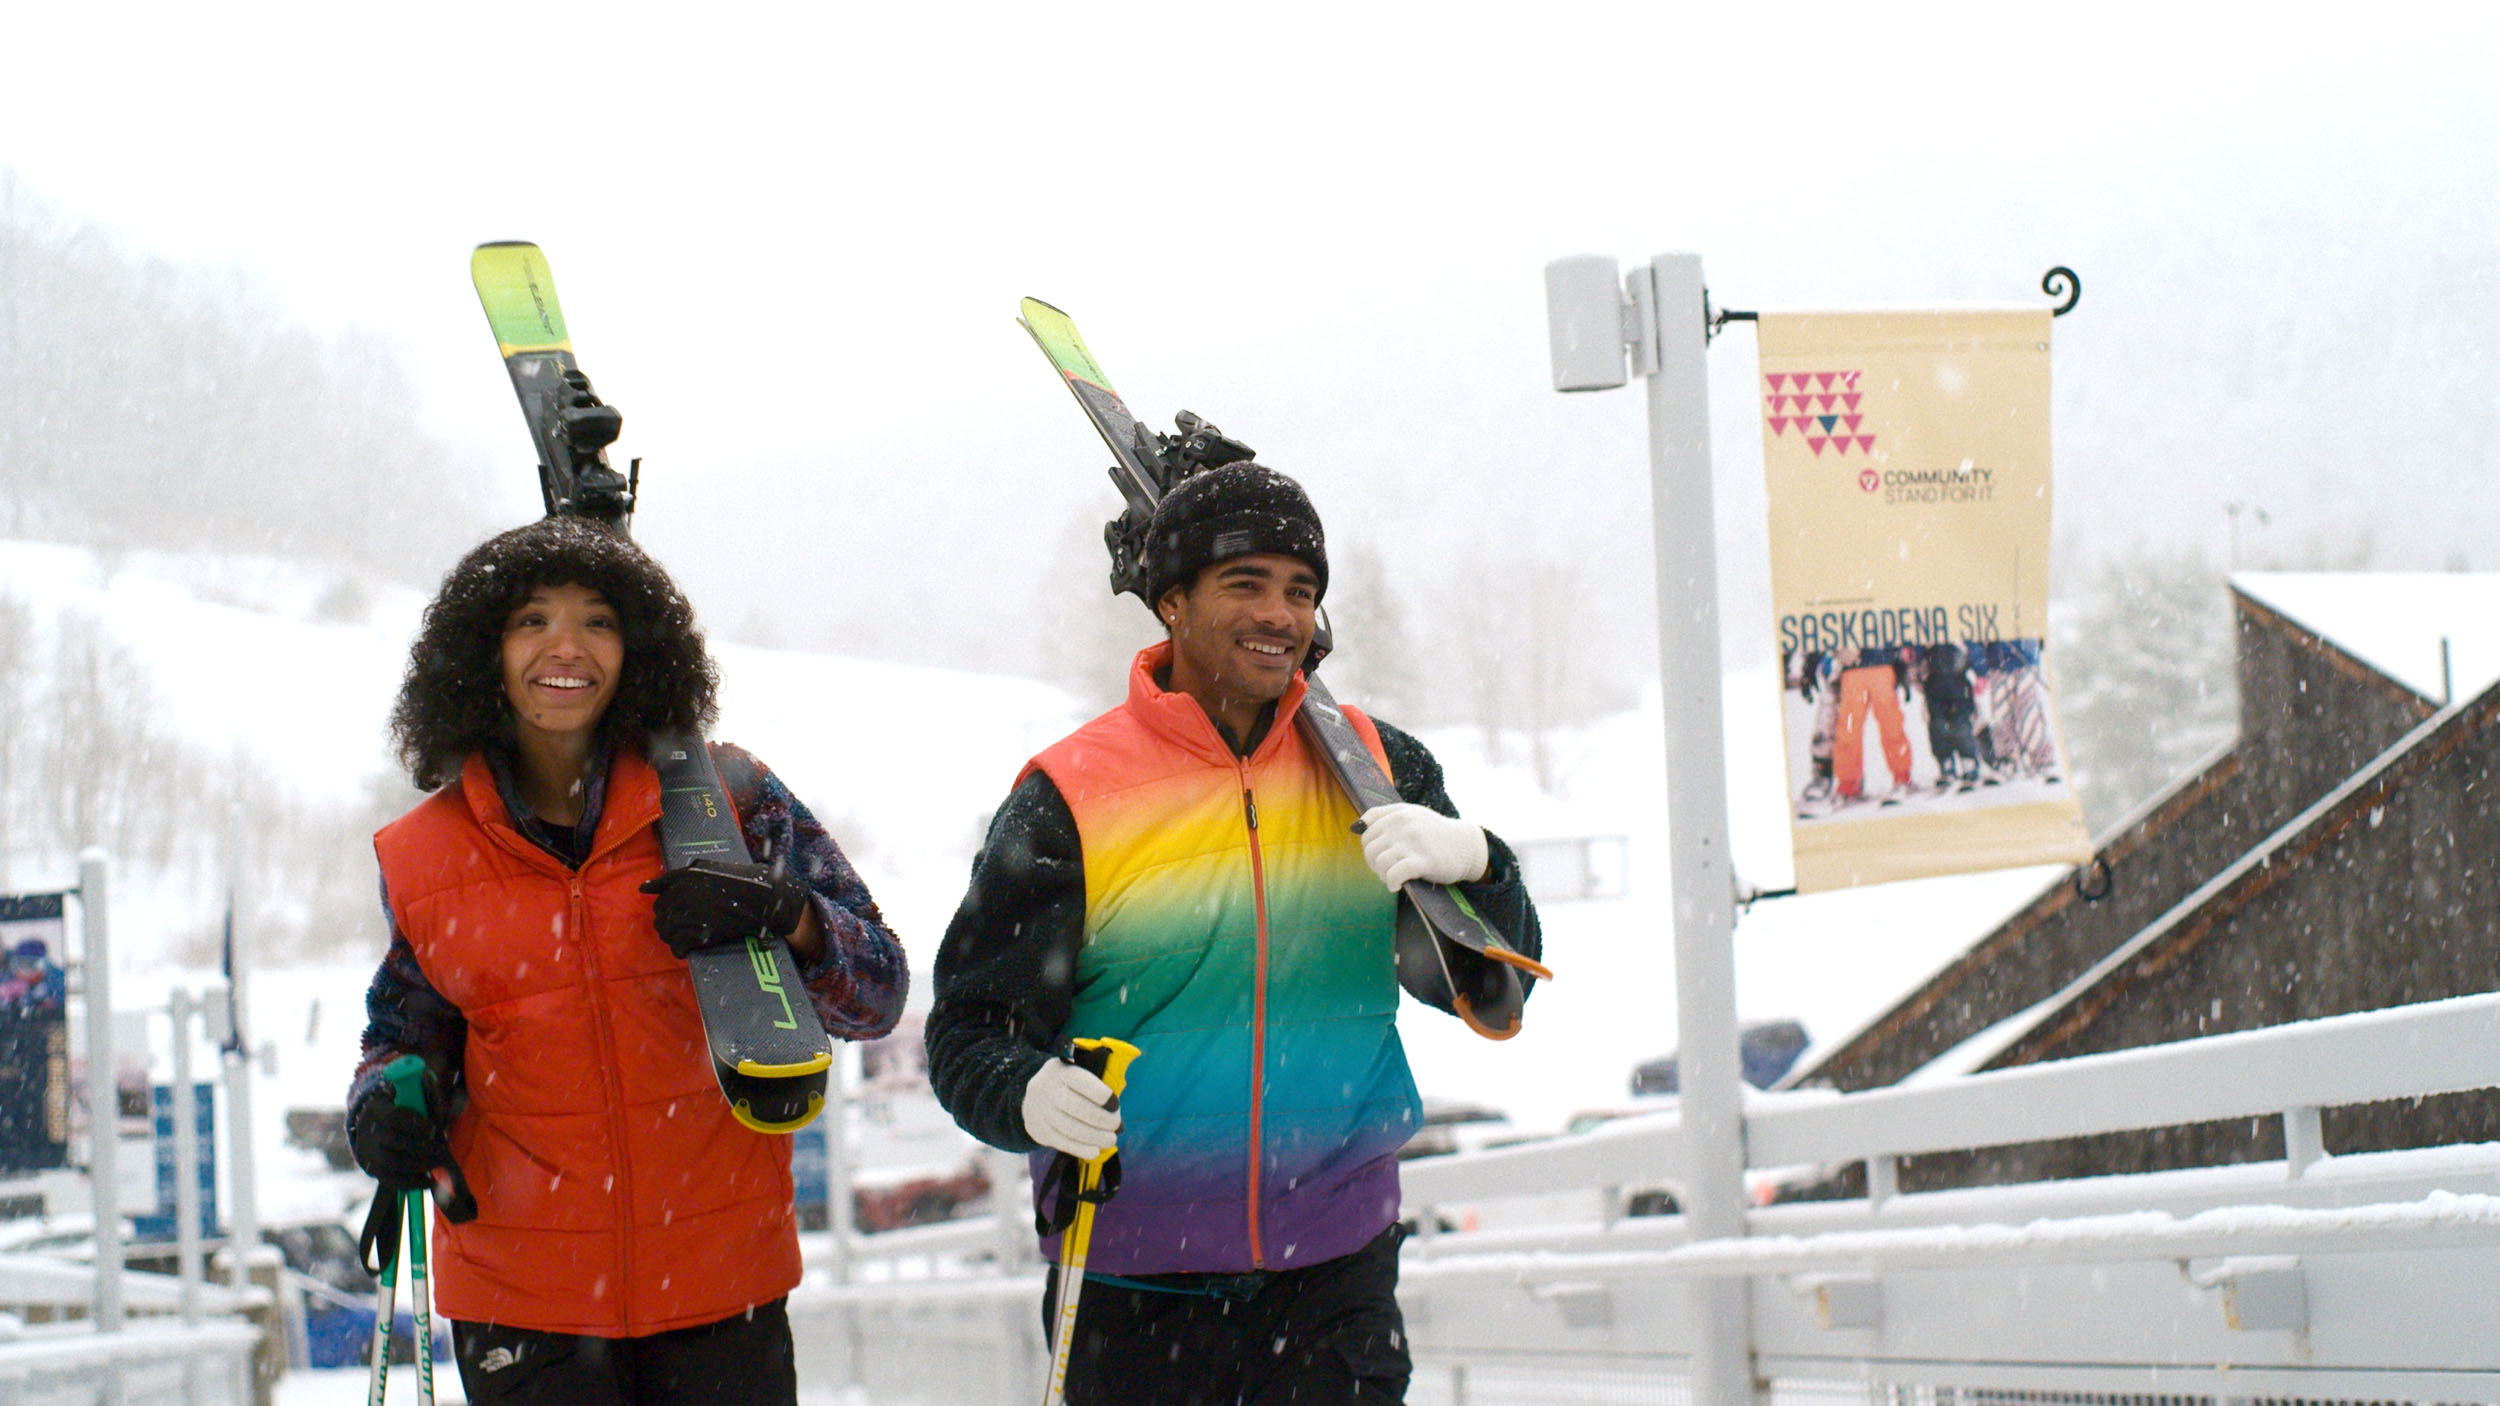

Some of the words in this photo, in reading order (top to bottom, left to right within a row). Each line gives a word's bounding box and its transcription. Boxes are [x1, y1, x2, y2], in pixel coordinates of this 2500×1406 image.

[1885, 487, 1938, 505] STAND
[1941, 485, 1976, 504] FOR
[1780, 606, 1950, 653] SASKADENA
[1958, 603, 2001, 642] SIX
[702, 792, 718, 818] 140
